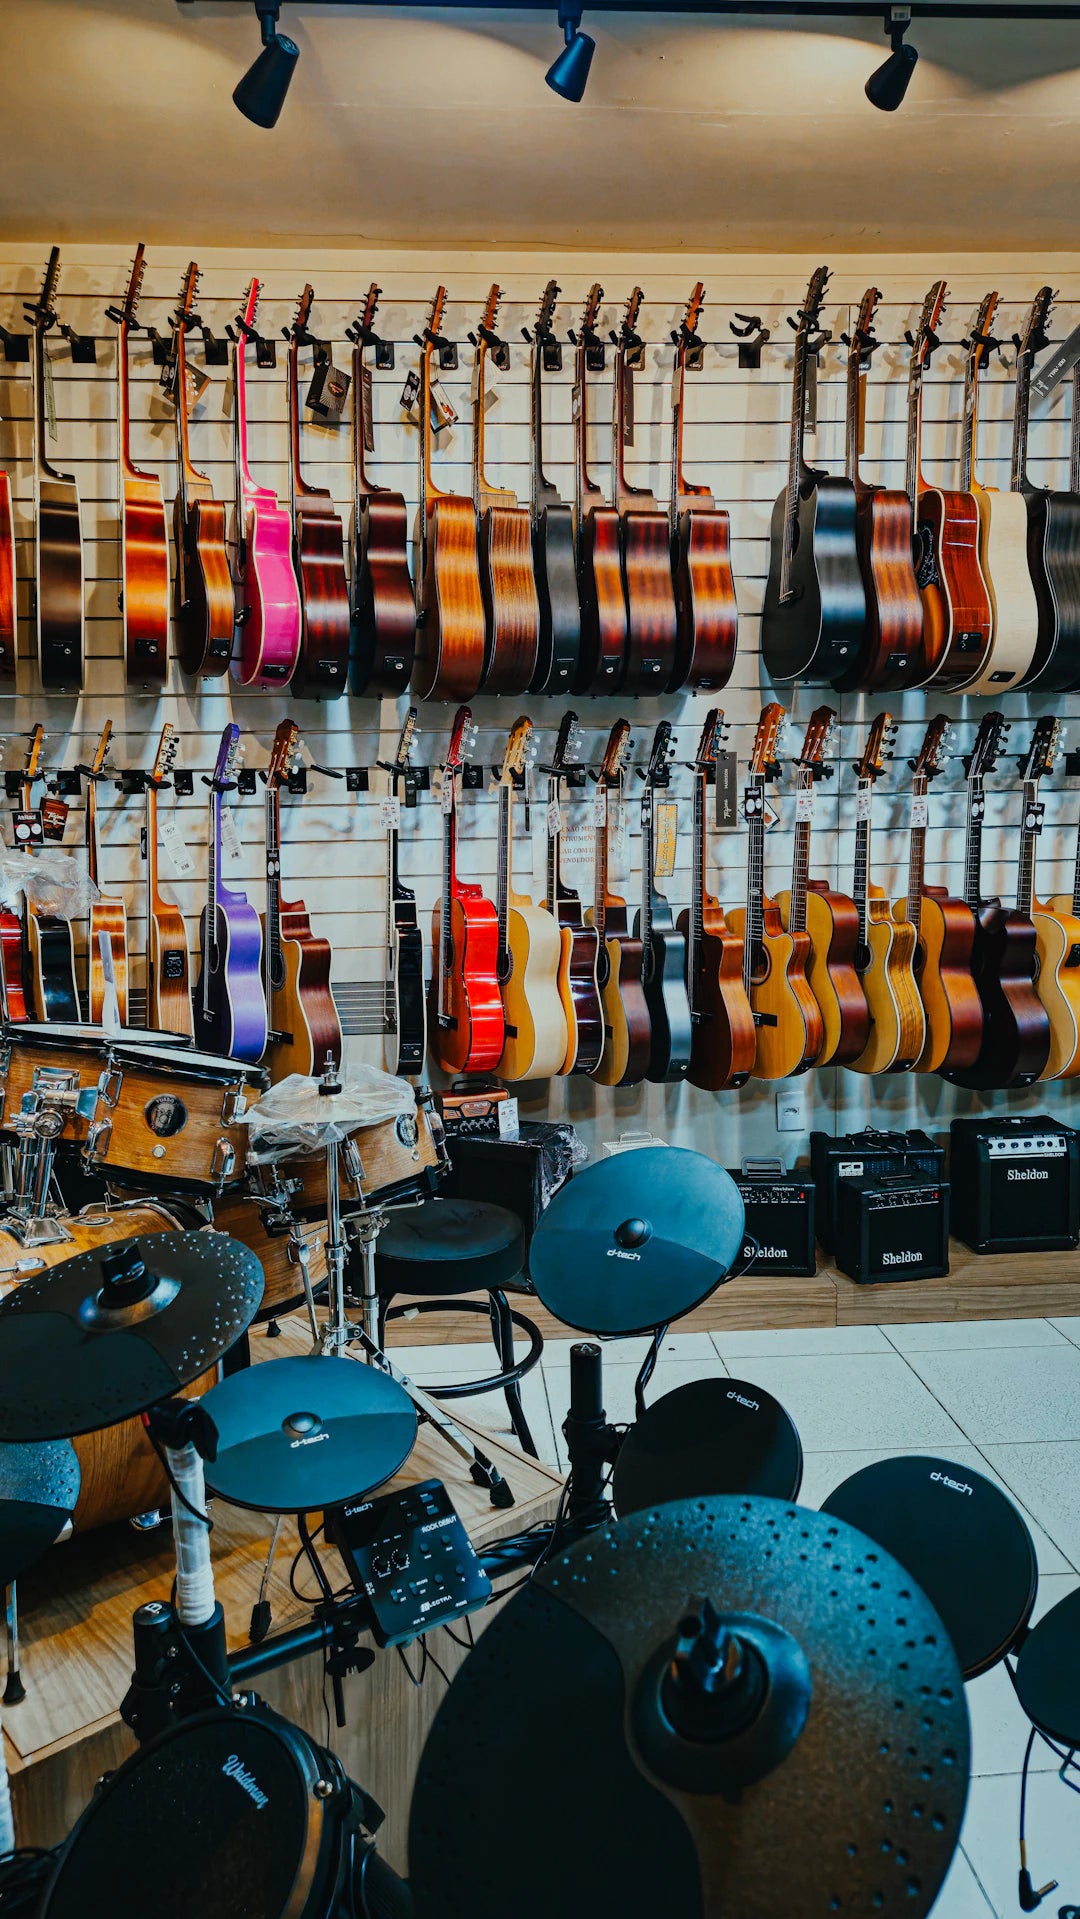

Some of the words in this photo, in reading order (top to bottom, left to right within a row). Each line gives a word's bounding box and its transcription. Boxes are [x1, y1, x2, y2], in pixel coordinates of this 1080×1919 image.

[1007, 1168, 1049, 1181] Sheldon
[606, 1248, 641, 1261] d-tech
[882, 1250, 923, 1265] Sheldon
[726, 1391, 760, 1411] d-tech
[290, 1433, 330, 1449] d-tech
[929, 1471, 973, 1496] d-tech
[344, 1502, 374, 1517] d-tech
[421, 1521, 440, 1534] ROCK
[222, 1754, 269, 1810] Waldman
